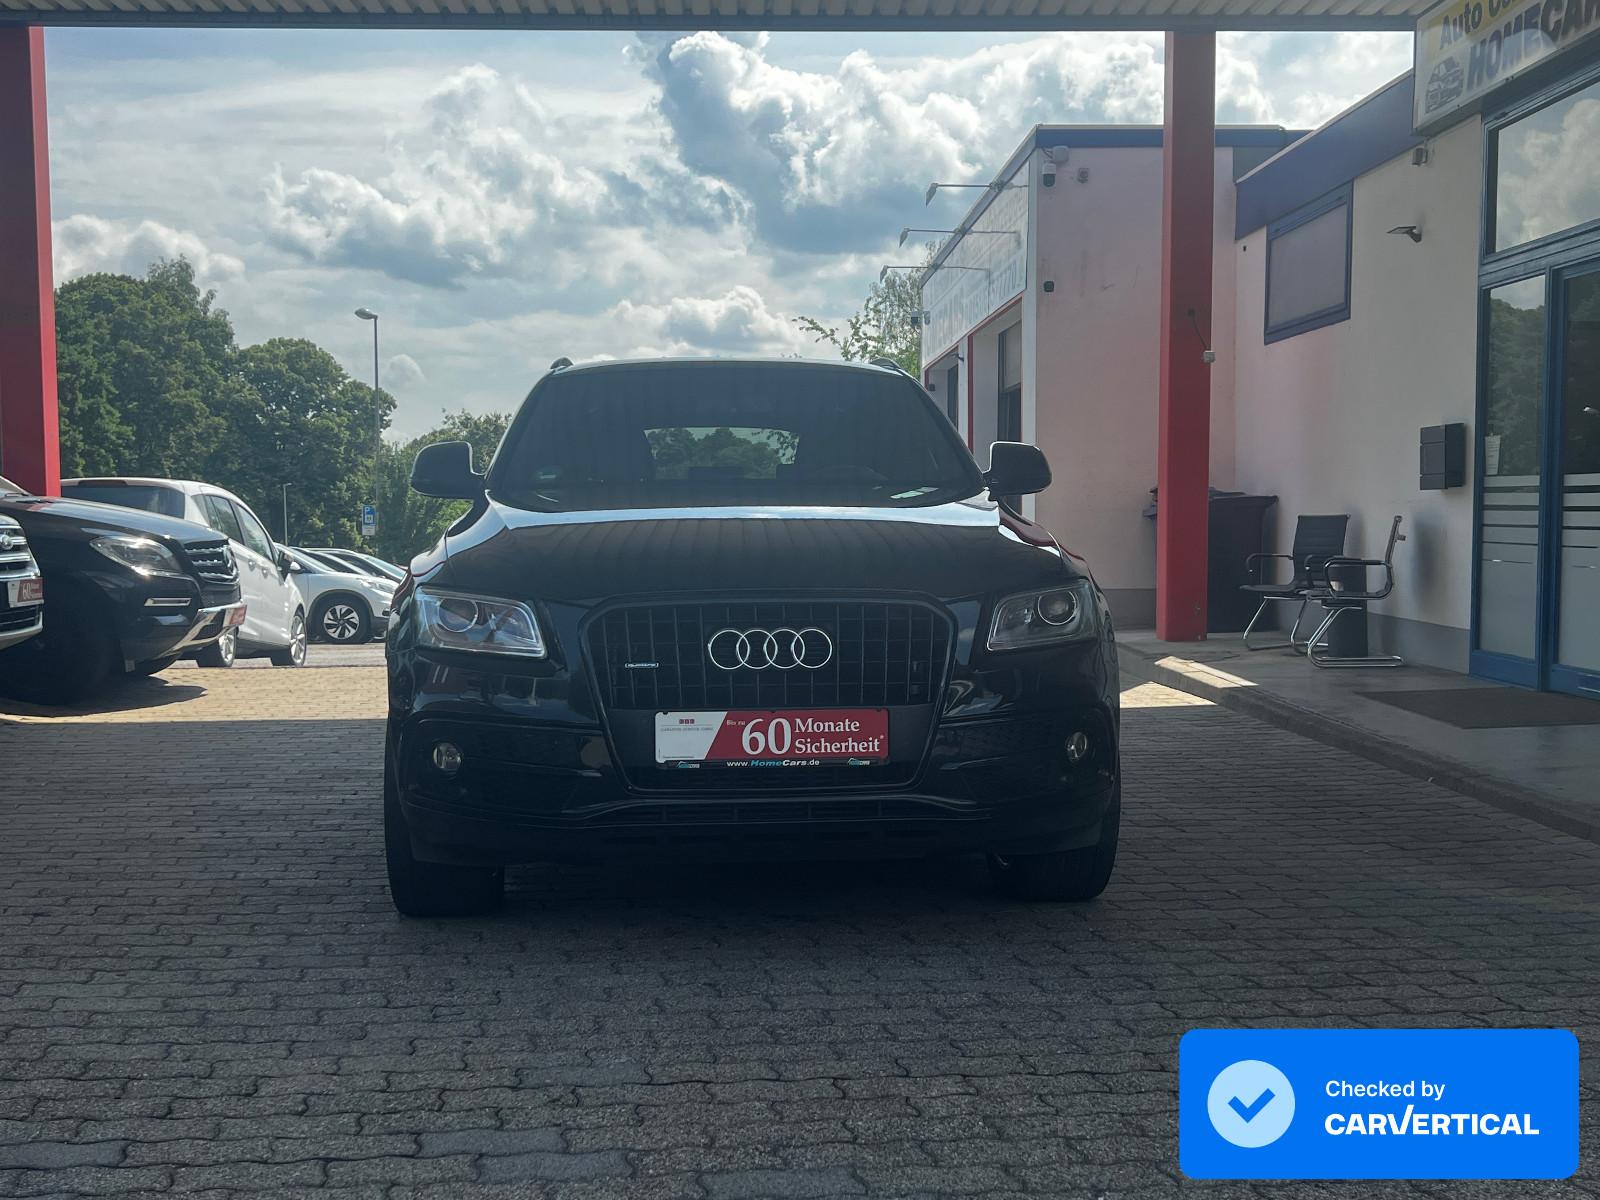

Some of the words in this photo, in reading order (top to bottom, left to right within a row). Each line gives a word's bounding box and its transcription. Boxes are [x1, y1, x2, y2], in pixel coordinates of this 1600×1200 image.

[1440, 2, 1483, 49] Auto
[741, 717, 792, 756] 60
[794, 717, 860, 733] Monate
[726, 758, 820, 768] www.HomeCars.de
